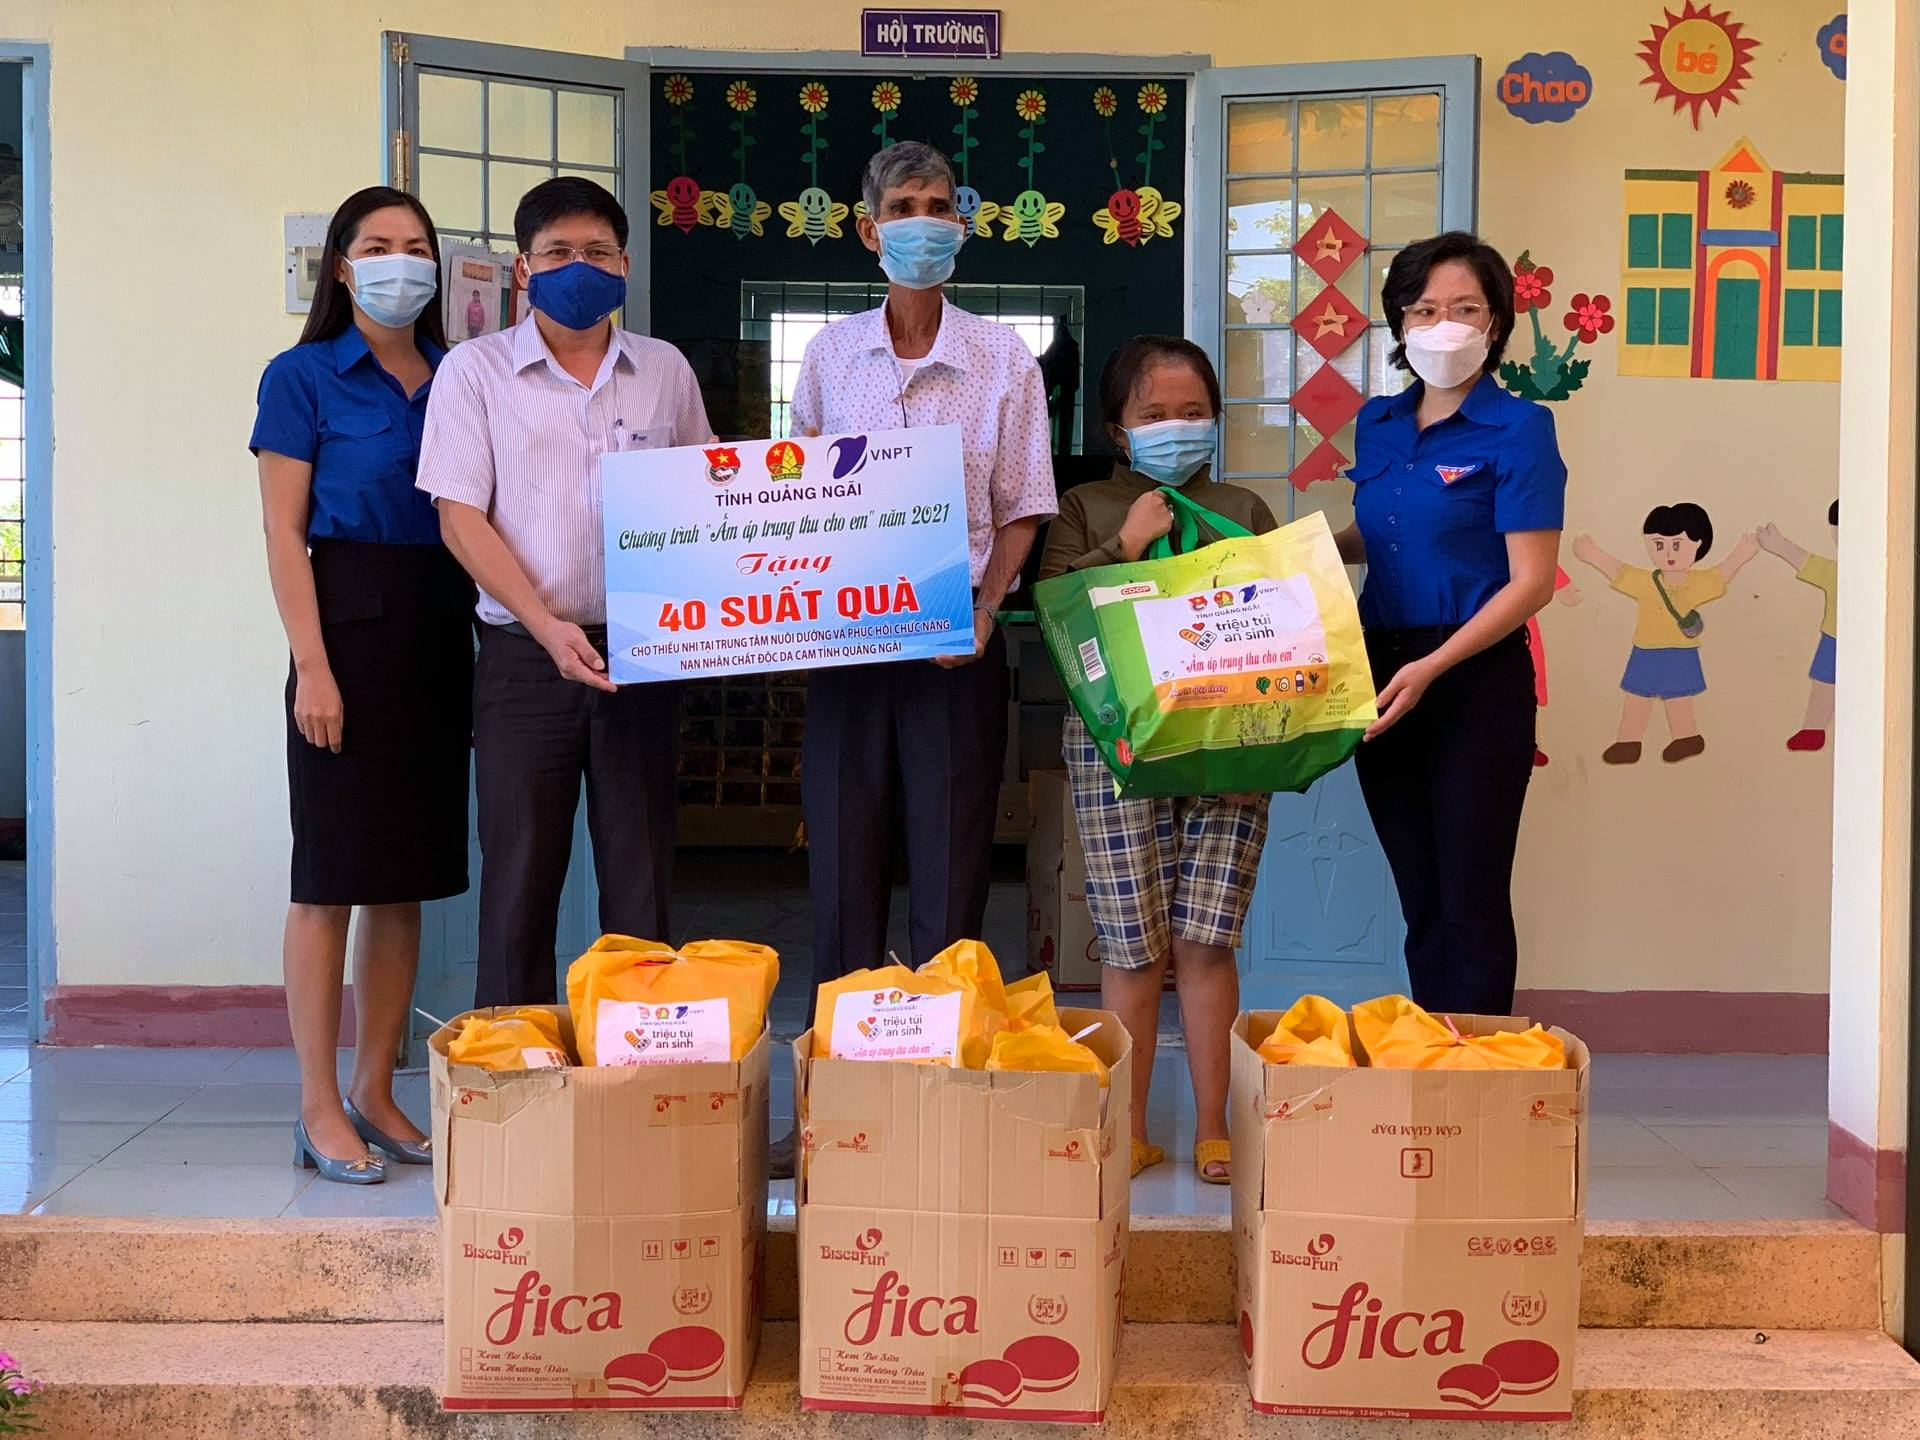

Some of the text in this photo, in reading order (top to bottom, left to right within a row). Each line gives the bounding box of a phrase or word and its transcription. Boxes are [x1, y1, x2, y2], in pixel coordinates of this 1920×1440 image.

[877, 19, 985, 47] HỘI TRƯỜNG
[1675, 42, 1718, 75] bé
[1502, 69, 1586, 104] Chào
[870, 447, 913, 461] VNPT
[715, 481, 862, 507] TỈNH QUẢNG NGÃI
[618, 503, 950, 552] Chương trình "Ấm áp trung thu cho em" năm 2021
[736, 552, 833, 577] Tặng
[1259, 586, 1279, 595] VNPT
[658, 576, 921, 632] 40 SUẤT QUÀ
[1216, 614, 1271, 633] triệu túi
[1224, 627, 1274, 643] an sinh
[631, 645, 650, 657] CHO
[653, 640, 679, 656] THIẾU
[682, 641, 698, 653] NHI
[701, 639, 714, 654] TẠI
[716, 637, 747, 650] TRUNG
[749, 634, 768, 646] TÂM
[771, 631, 795, 645] NUÔI
[797, 629, 831, 644] DƯỠNG
[834, 627, 846, 639] VÀ
[848, 626, 872, 640] PHỤC
[895, 621, 920, 634] CHỨC
[923, 619, 950, 631] NĂNG
[681, 640, 901, 673] NẠN NHÂN CHẤT ĐỘC DA CAM TỈNH QUẢNG NGÃI
[1220, 654, 1243, 673] trung
[1246, 651, 1259, 666] thu
[1262, 649, 1277, 663] cho
[883, 1014, 922, 1028] triệu túi
[885, 1025, 922, 1037] an sinh
[652, 1029, 693, 1040] triệu túi
[656, 1039, 693, 1049] an sinh
[485, 1270, 623, 1346] fica
[844, 1270, 979, 1346] fica
[1511, 1299, 1531, 1318] 252
[1301, 1281, 1466, 1370] fica
